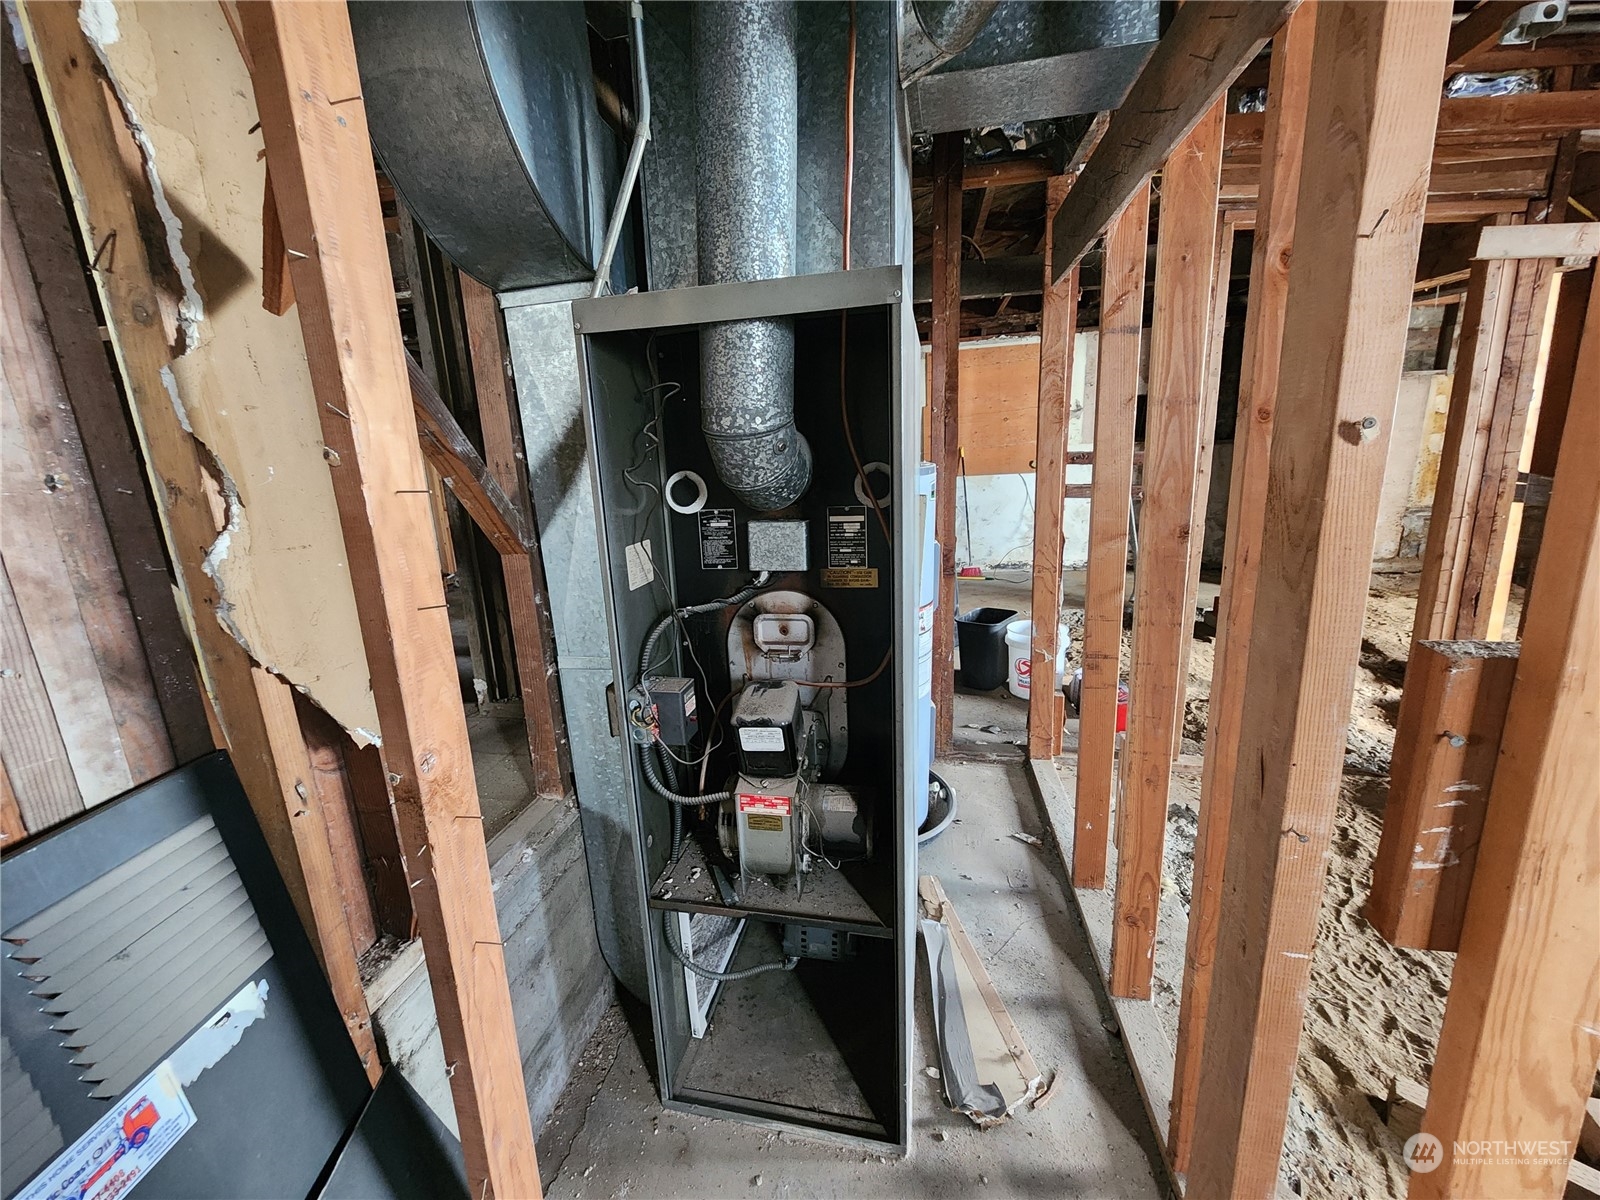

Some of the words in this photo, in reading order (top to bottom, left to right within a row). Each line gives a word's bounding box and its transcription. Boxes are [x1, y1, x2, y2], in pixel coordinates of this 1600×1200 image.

[48, 1156, 76, 1182] HOME
[75, 1115, 118, 1157] SERVICED
[117, 1104, 128, 1118] BY
[61, 1159, 93, 1190] Coast
